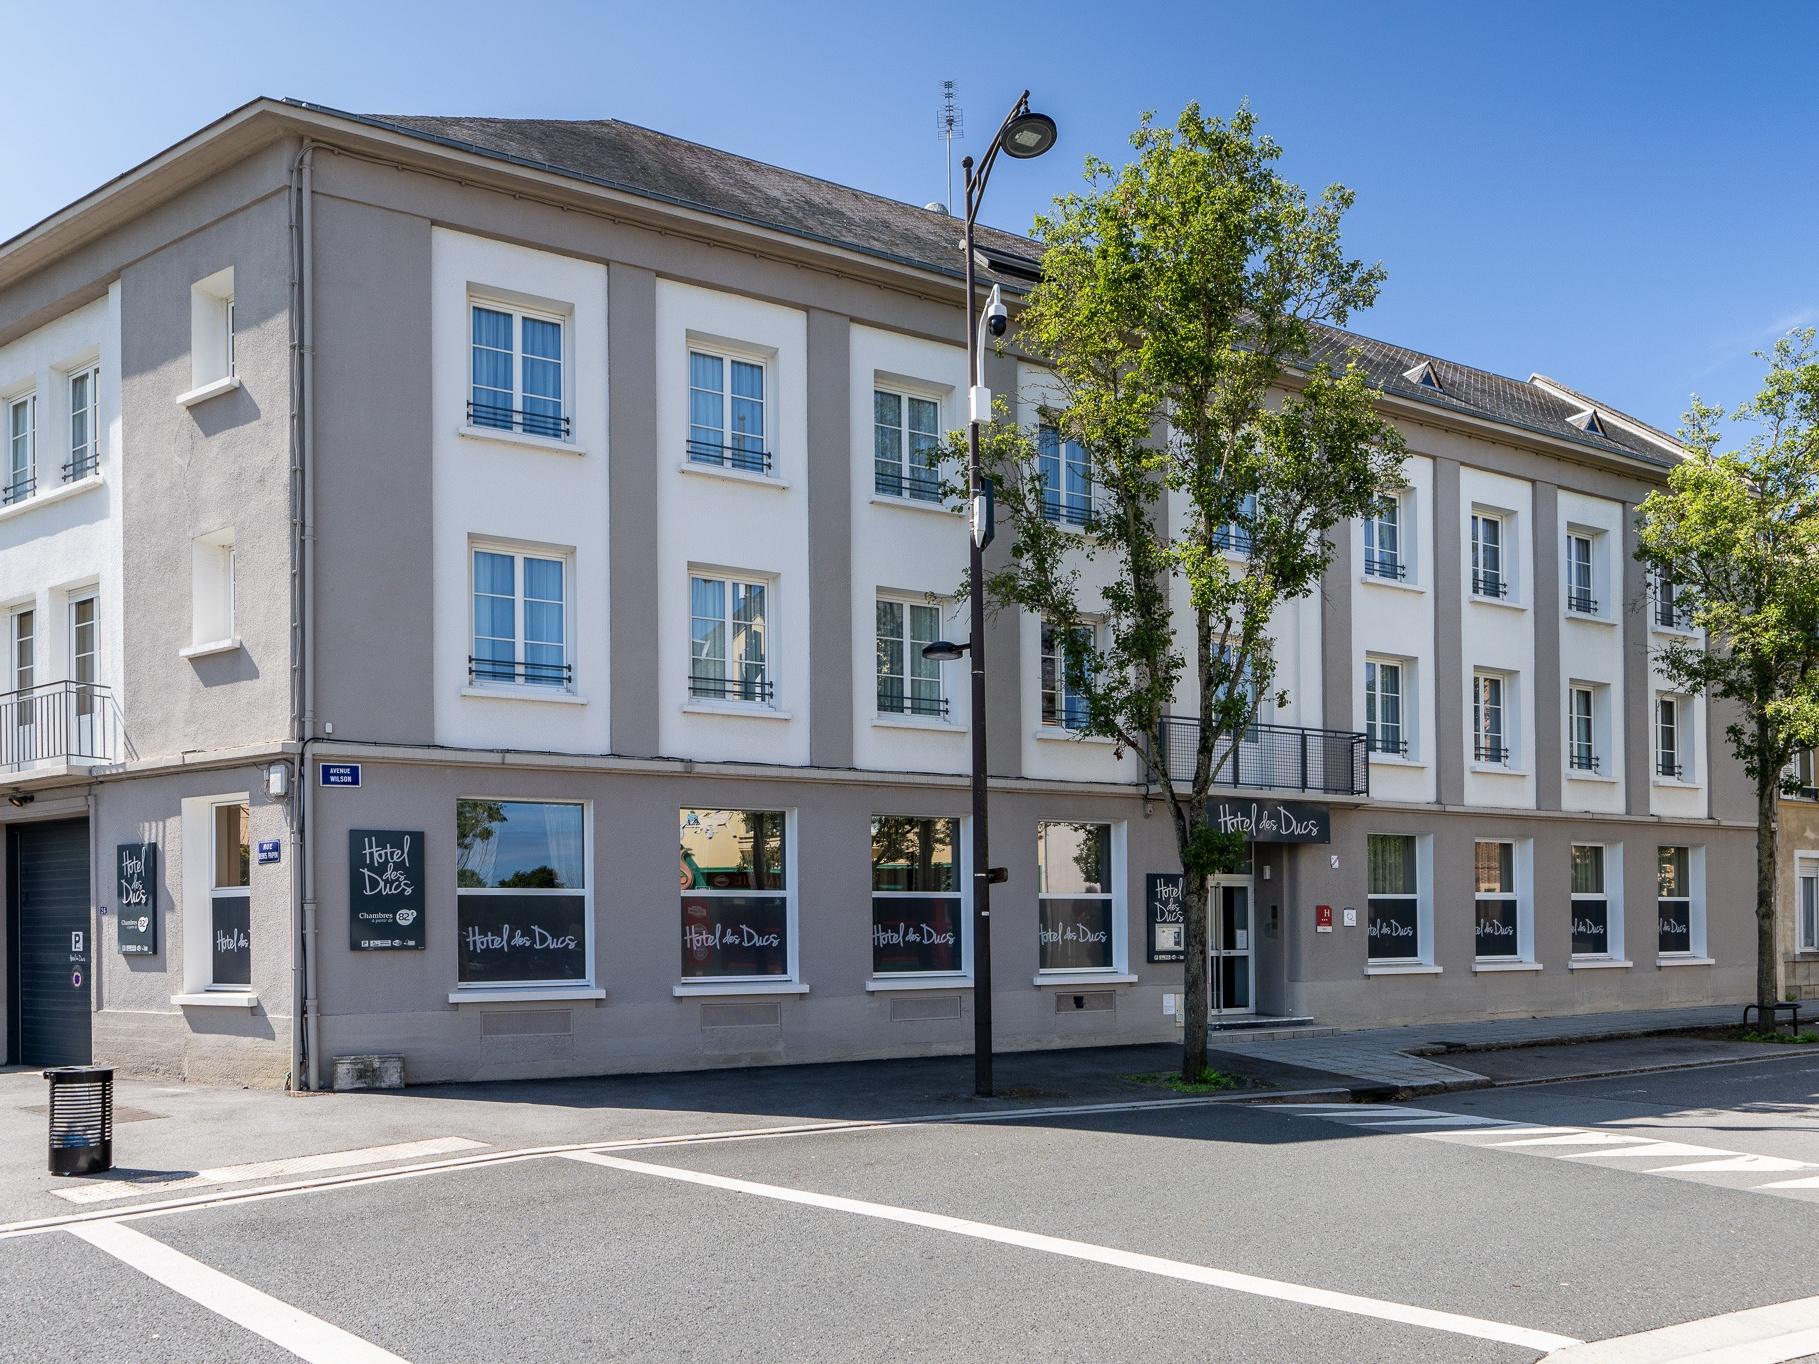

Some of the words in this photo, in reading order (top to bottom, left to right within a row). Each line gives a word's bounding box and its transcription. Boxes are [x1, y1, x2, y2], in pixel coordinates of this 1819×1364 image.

[329, 775, 352, 783] WILSON
[1218, 803, 1257, 837] Hotel
[1259, 810, 1278, 831] des
[1277, 805, 1319, 837] Ducs
[122, 846, 147, 877] Hotel
[362, 835, 411, 867] Hotel
[131, 873, 143, 890] des
[360, 868, 414, 895] Ducs
[382, 862, 406, 882] des
[121, 879, 147, 904] Ducs
[1156, 878, 1183, 901] Hotel
[1154, 901, 1184, 922] Ducs
[1167, 898, 1180, 911] des
[1324, 909, 1330, 917] H
[466, 924, 509, 953] Hotel
[511, 929, 532, 947] des
[531, 925, 577, 949] Ducs
[684, 923, 722, 950] Hotel
[722, 928, 741, 944] des
[740, 924, 780, 947] Ducs
[873, 922, 904, 948] Hotel
[905, 927, 921, 942] des
[920, 922, 955, 944] Ducs
[1077, 922, 1108, 943] Ducs
[1368, 918, 1380, 938] tel
[1390, 919, 1413, 936] Ducs
[1492, 919, 1513, 936] Ducs
[74, 933, 81, 949] P
[217, 928, 238, 952] Hotel
[238, 932, 248, 948] des
